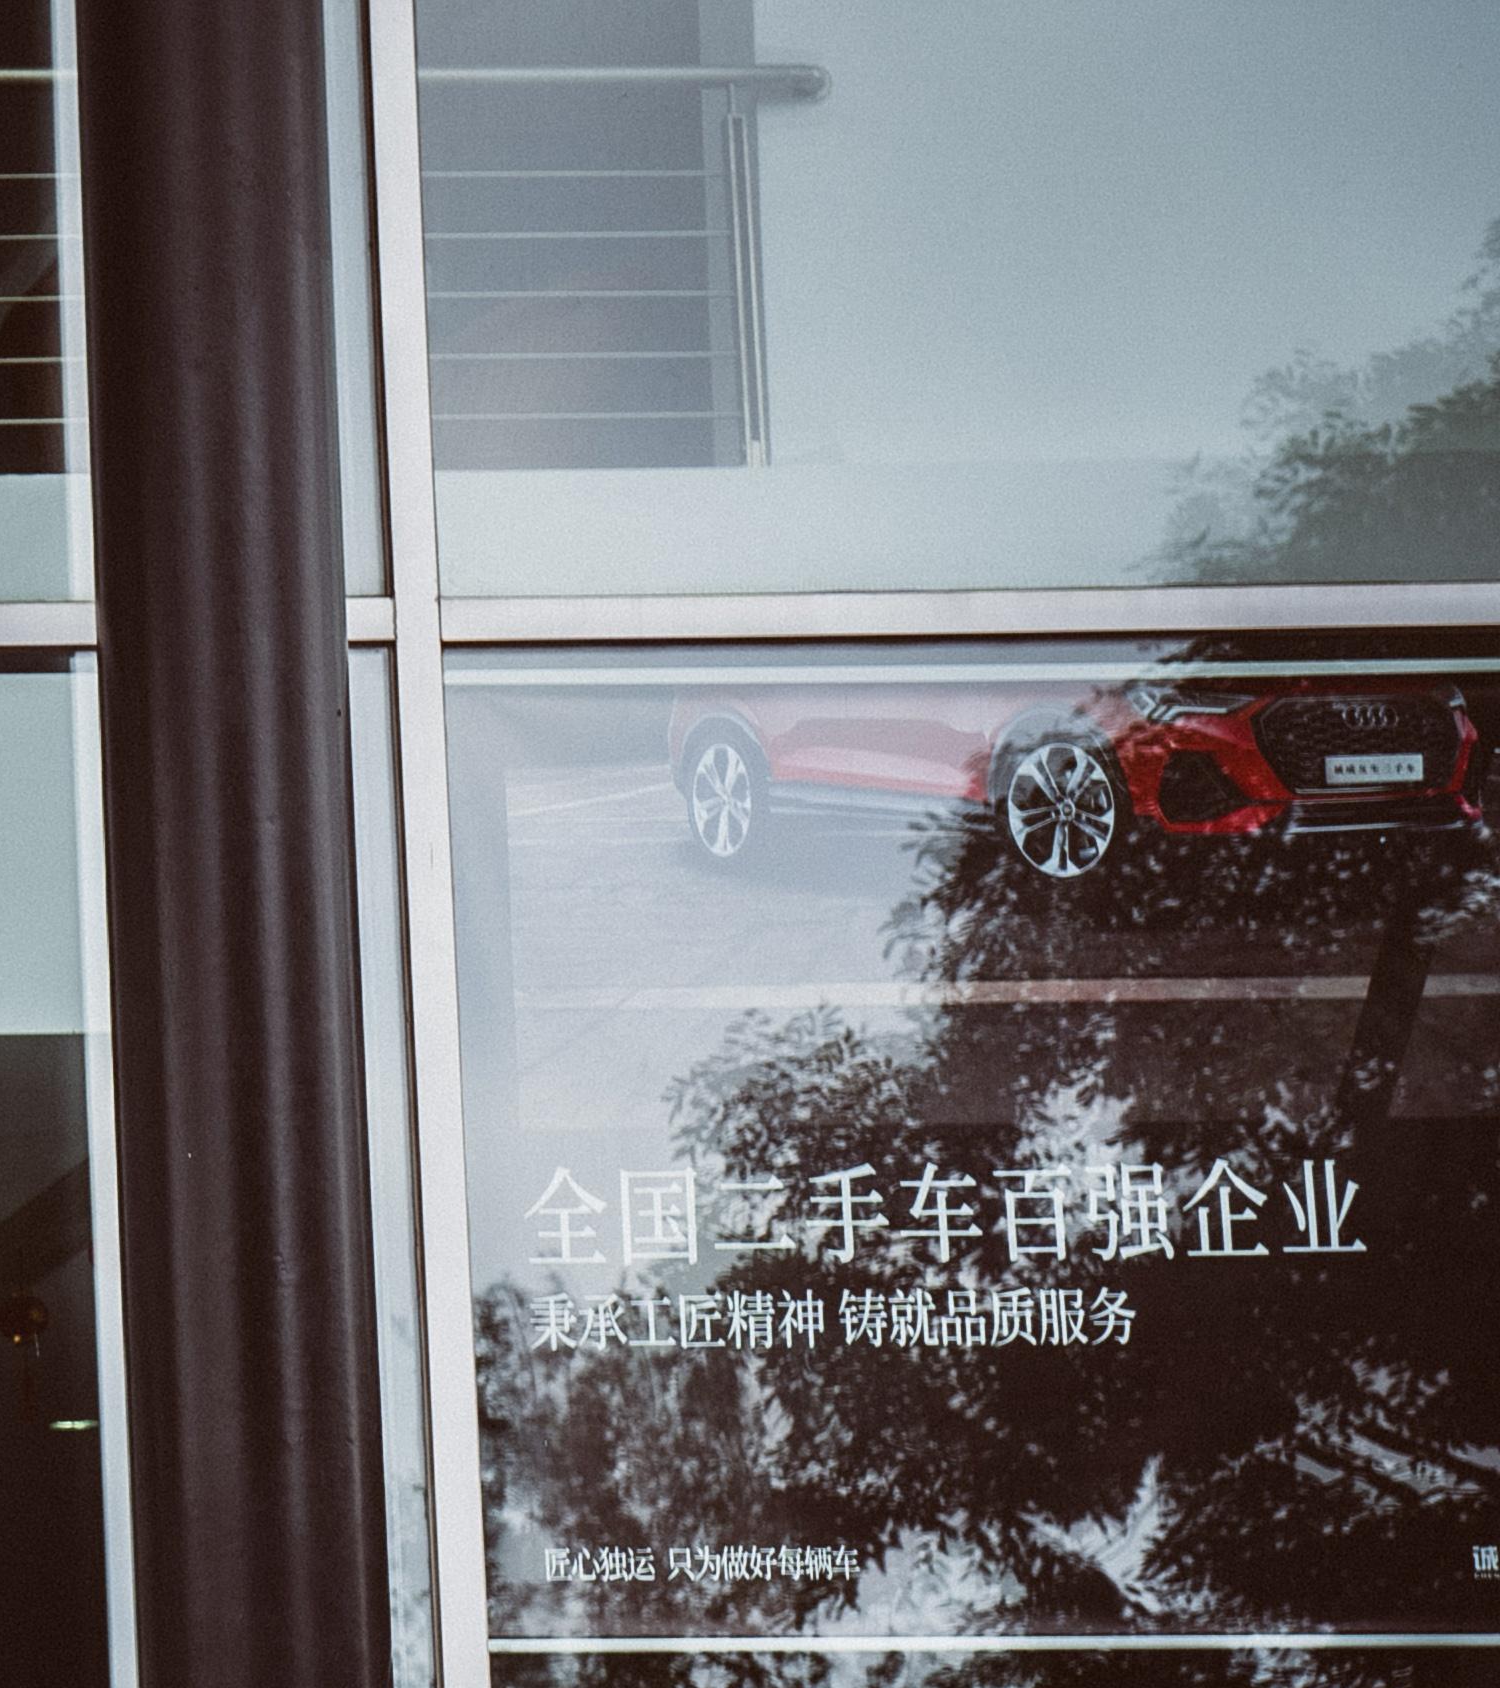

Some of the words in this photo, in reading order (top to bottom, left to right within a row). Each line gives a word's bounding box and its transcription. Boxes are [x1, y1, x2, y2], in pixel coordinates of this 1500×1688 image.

[522, 1156, 1369, 1268] 全国二手车百强企业
[527, 1290, 827, 1352] 秉承工匠精神
[838, 1285, 1138, 1349] 铸就品质服务
[542, 1546, 657, 1583] 匠心独运
[666, 1545, 861, 1584] 只为做好每辆车
